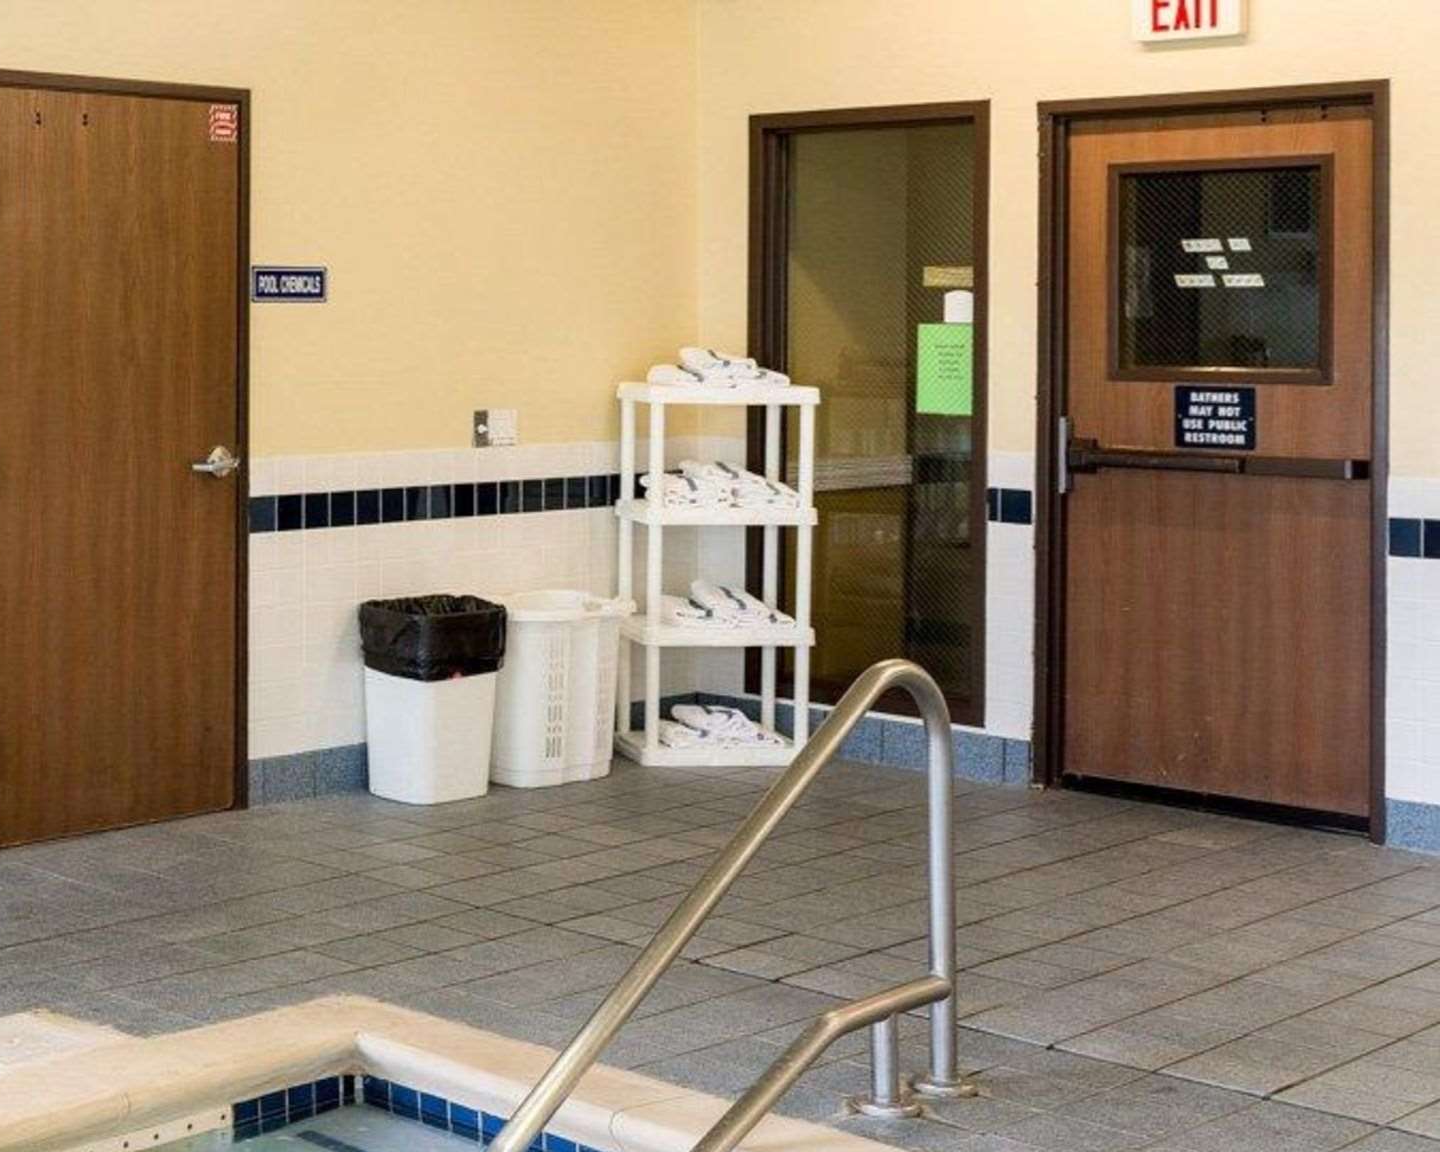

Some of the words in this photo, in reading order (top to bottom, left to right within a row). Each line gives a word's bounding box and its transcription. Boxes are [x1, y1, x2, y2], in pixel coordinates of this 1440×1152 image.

[1189, 392, 1240, 404] BATHERS
[1188, 405, 1214, 416] MAY
[1217, 406, 1241, 417] NOT
[1181, 418, 1204, 430] USE
[1208, 419, 1247, 431] PUBLIC
[1184, 432, 1246, 445] RESTROOM
